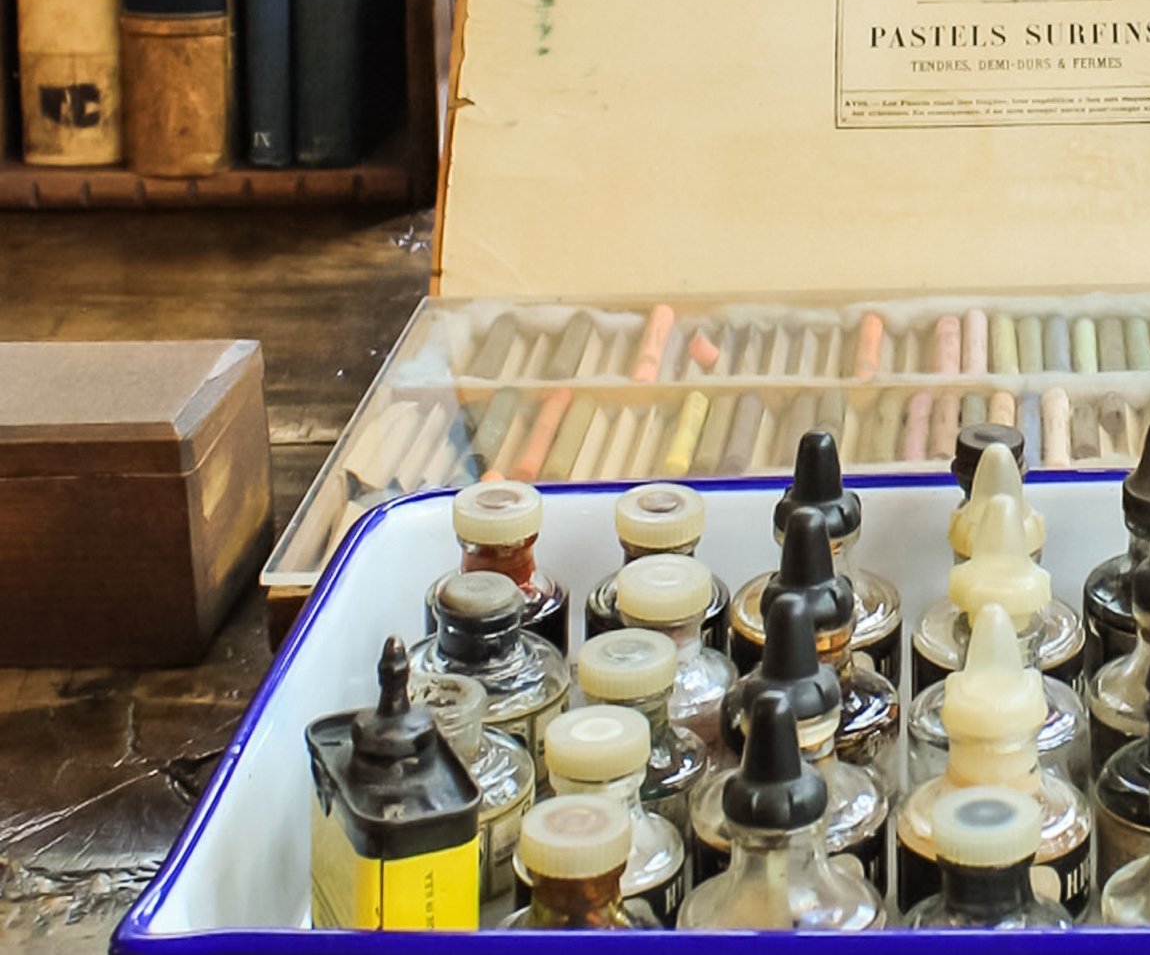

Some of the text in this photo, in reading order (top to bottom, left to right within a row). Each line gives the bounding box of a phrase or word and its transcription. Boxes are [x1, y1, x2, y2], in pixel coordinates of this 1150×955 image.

[870, 25, 1007, 48] PASTELS
[910, 56, 1122, 72] TENDRES, DEMI-DURS & FERMES
[254, 132, 271, 147] IX
